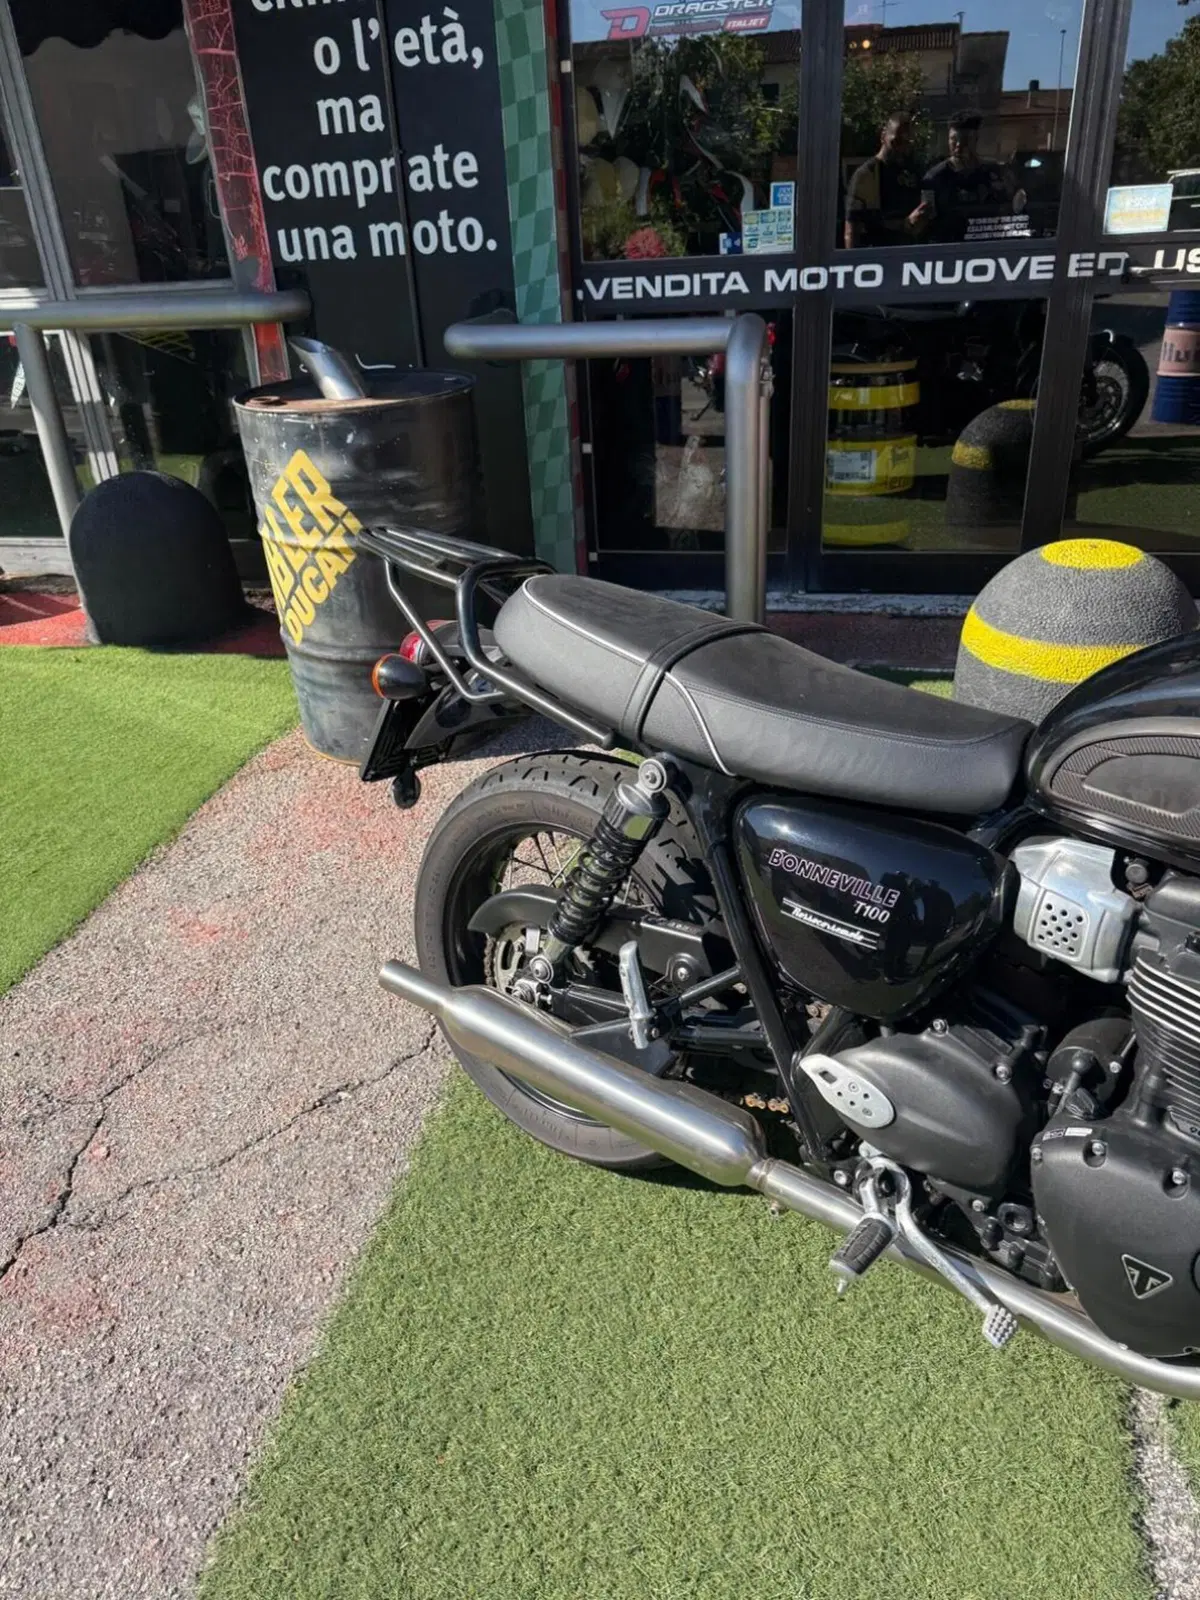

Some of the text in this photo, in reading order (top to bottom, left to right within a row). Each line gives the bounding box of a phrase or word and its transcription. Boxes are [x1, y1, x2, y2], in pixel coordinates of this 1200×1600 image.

[653, 0, 774, 17] DRAGSTER
[313, 36, 341, 76] o
[316, 94, 386, 136] ma
[262, 143, 479, 209] comprate
[276, 208, 498, 263] una moto.
[764, 263, 883, 293] MOTO
[901, 255, 1056, 286] NUOVE
[284, 511, 364, 646] DUCATI
[768, 848, 901, 908] BONNEVILLE
[853, 900, 891, 924] T100
